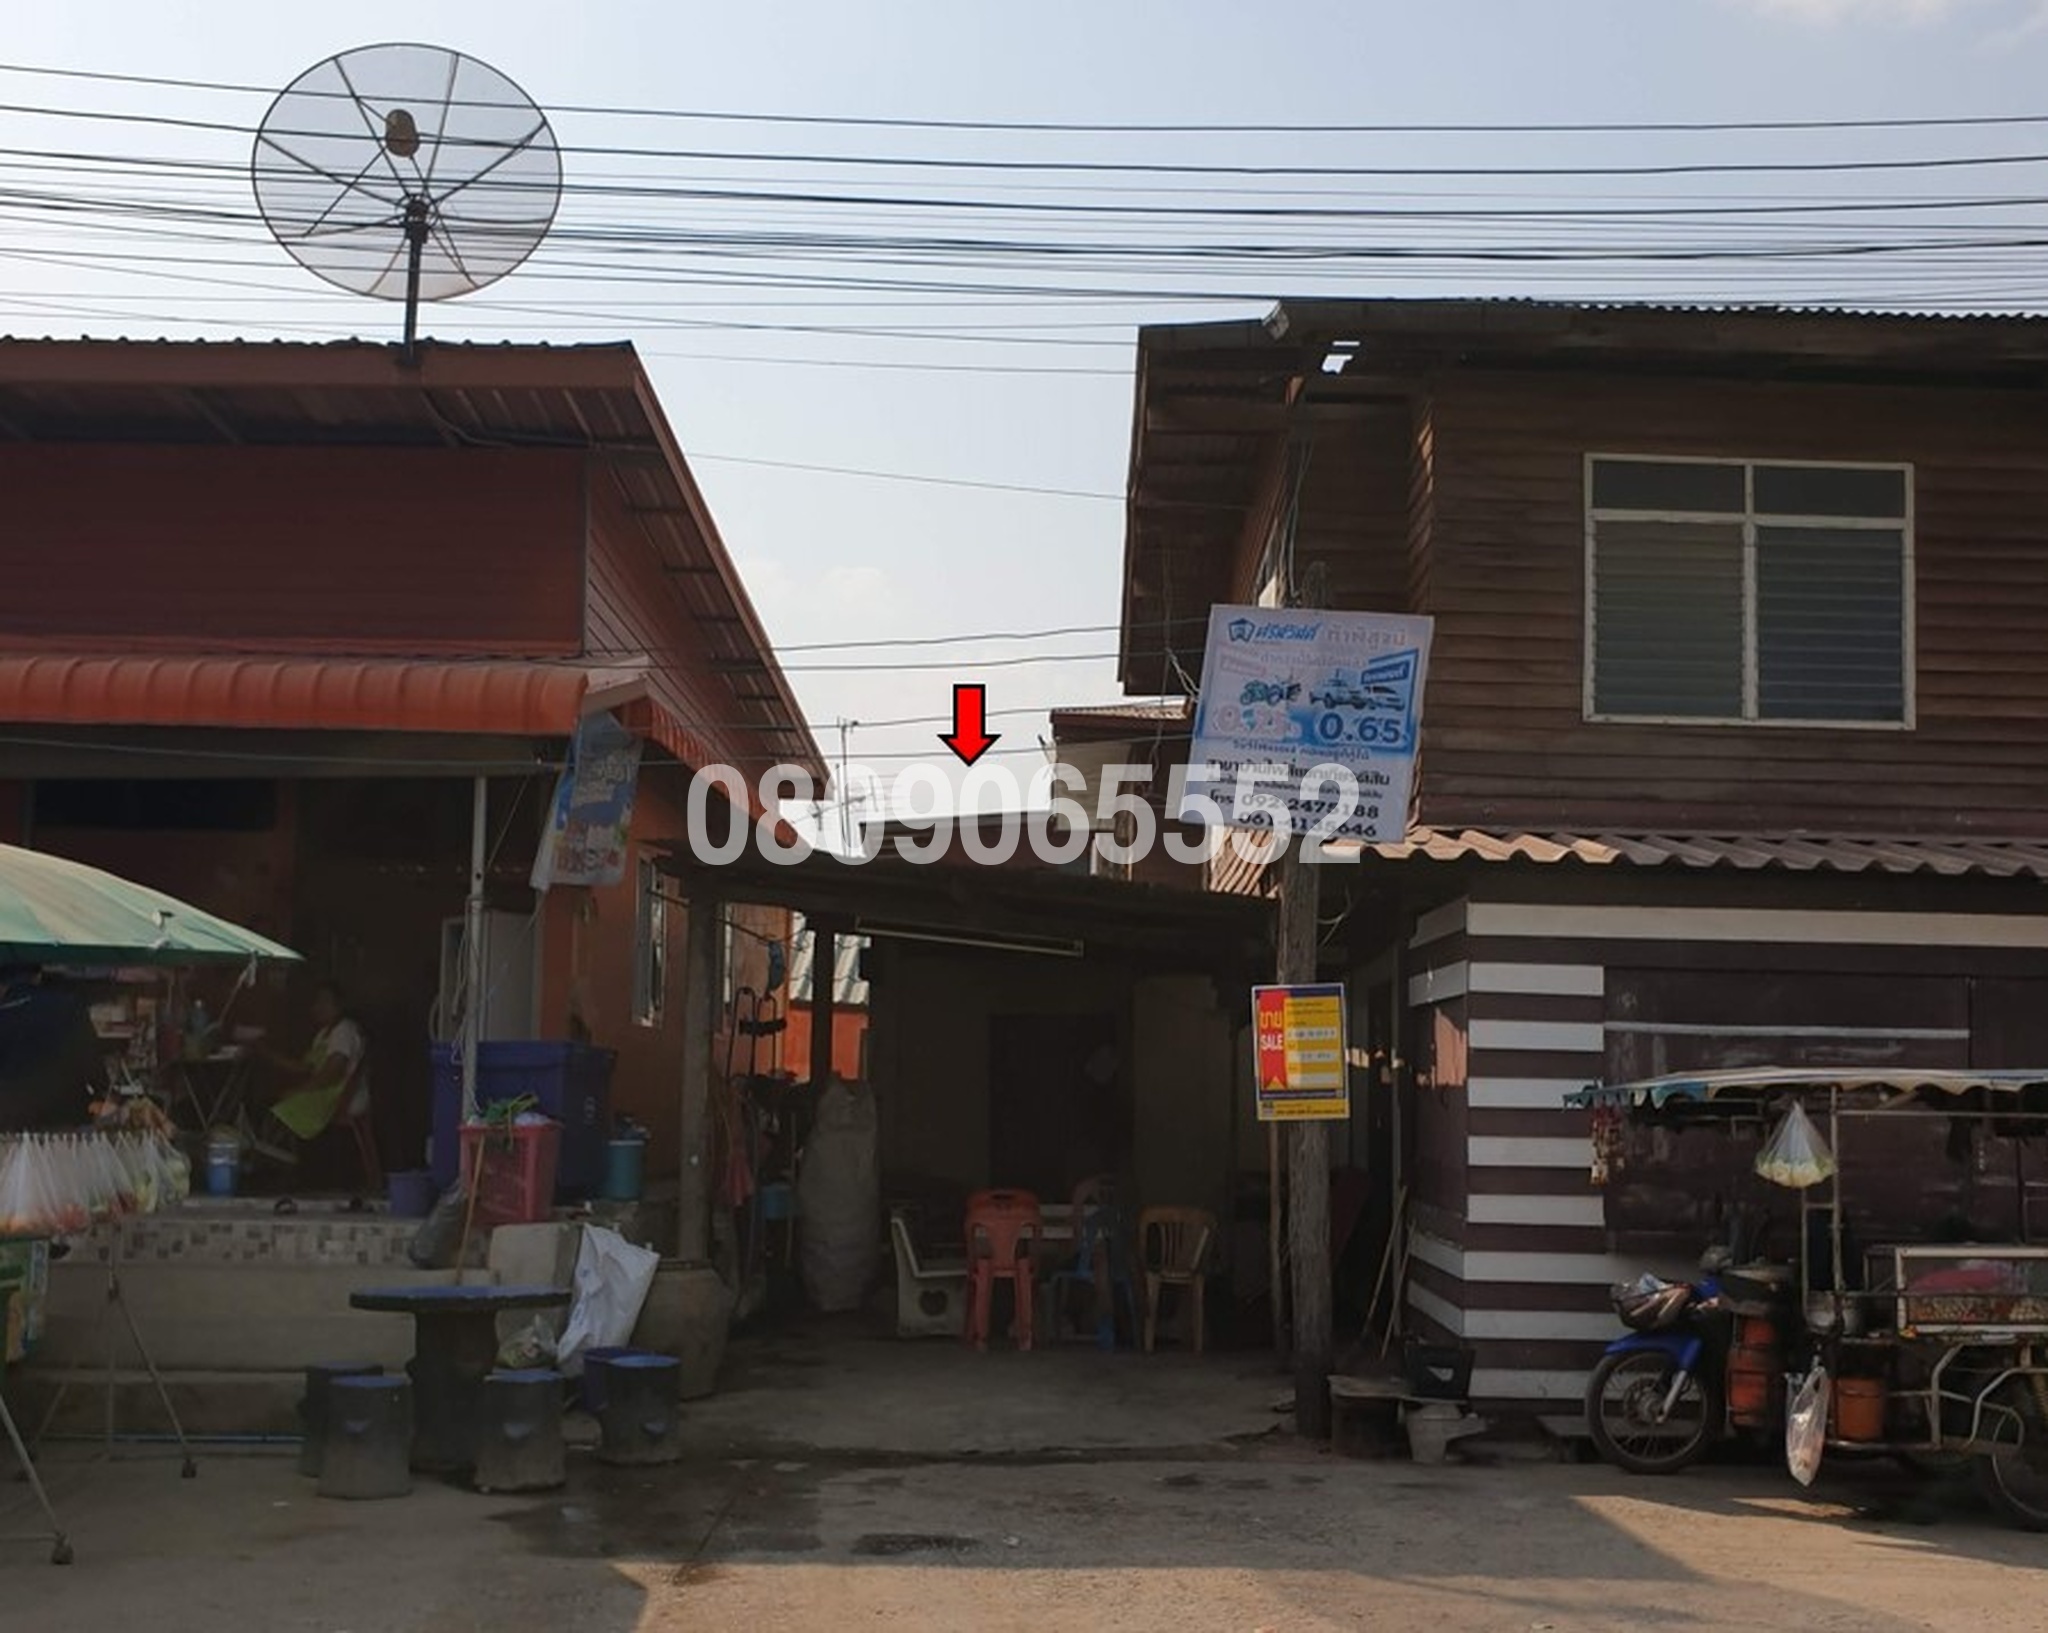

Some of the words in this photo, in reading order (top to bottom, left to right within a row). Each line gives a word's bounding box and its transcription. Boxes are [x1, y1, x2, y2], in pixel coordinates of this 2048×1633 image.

[1317, 712, 1402, 744] 0.65
[1260, 1010, 1283, 1029] ขาย
[1260, 1032, 1284, 1051] SALE
